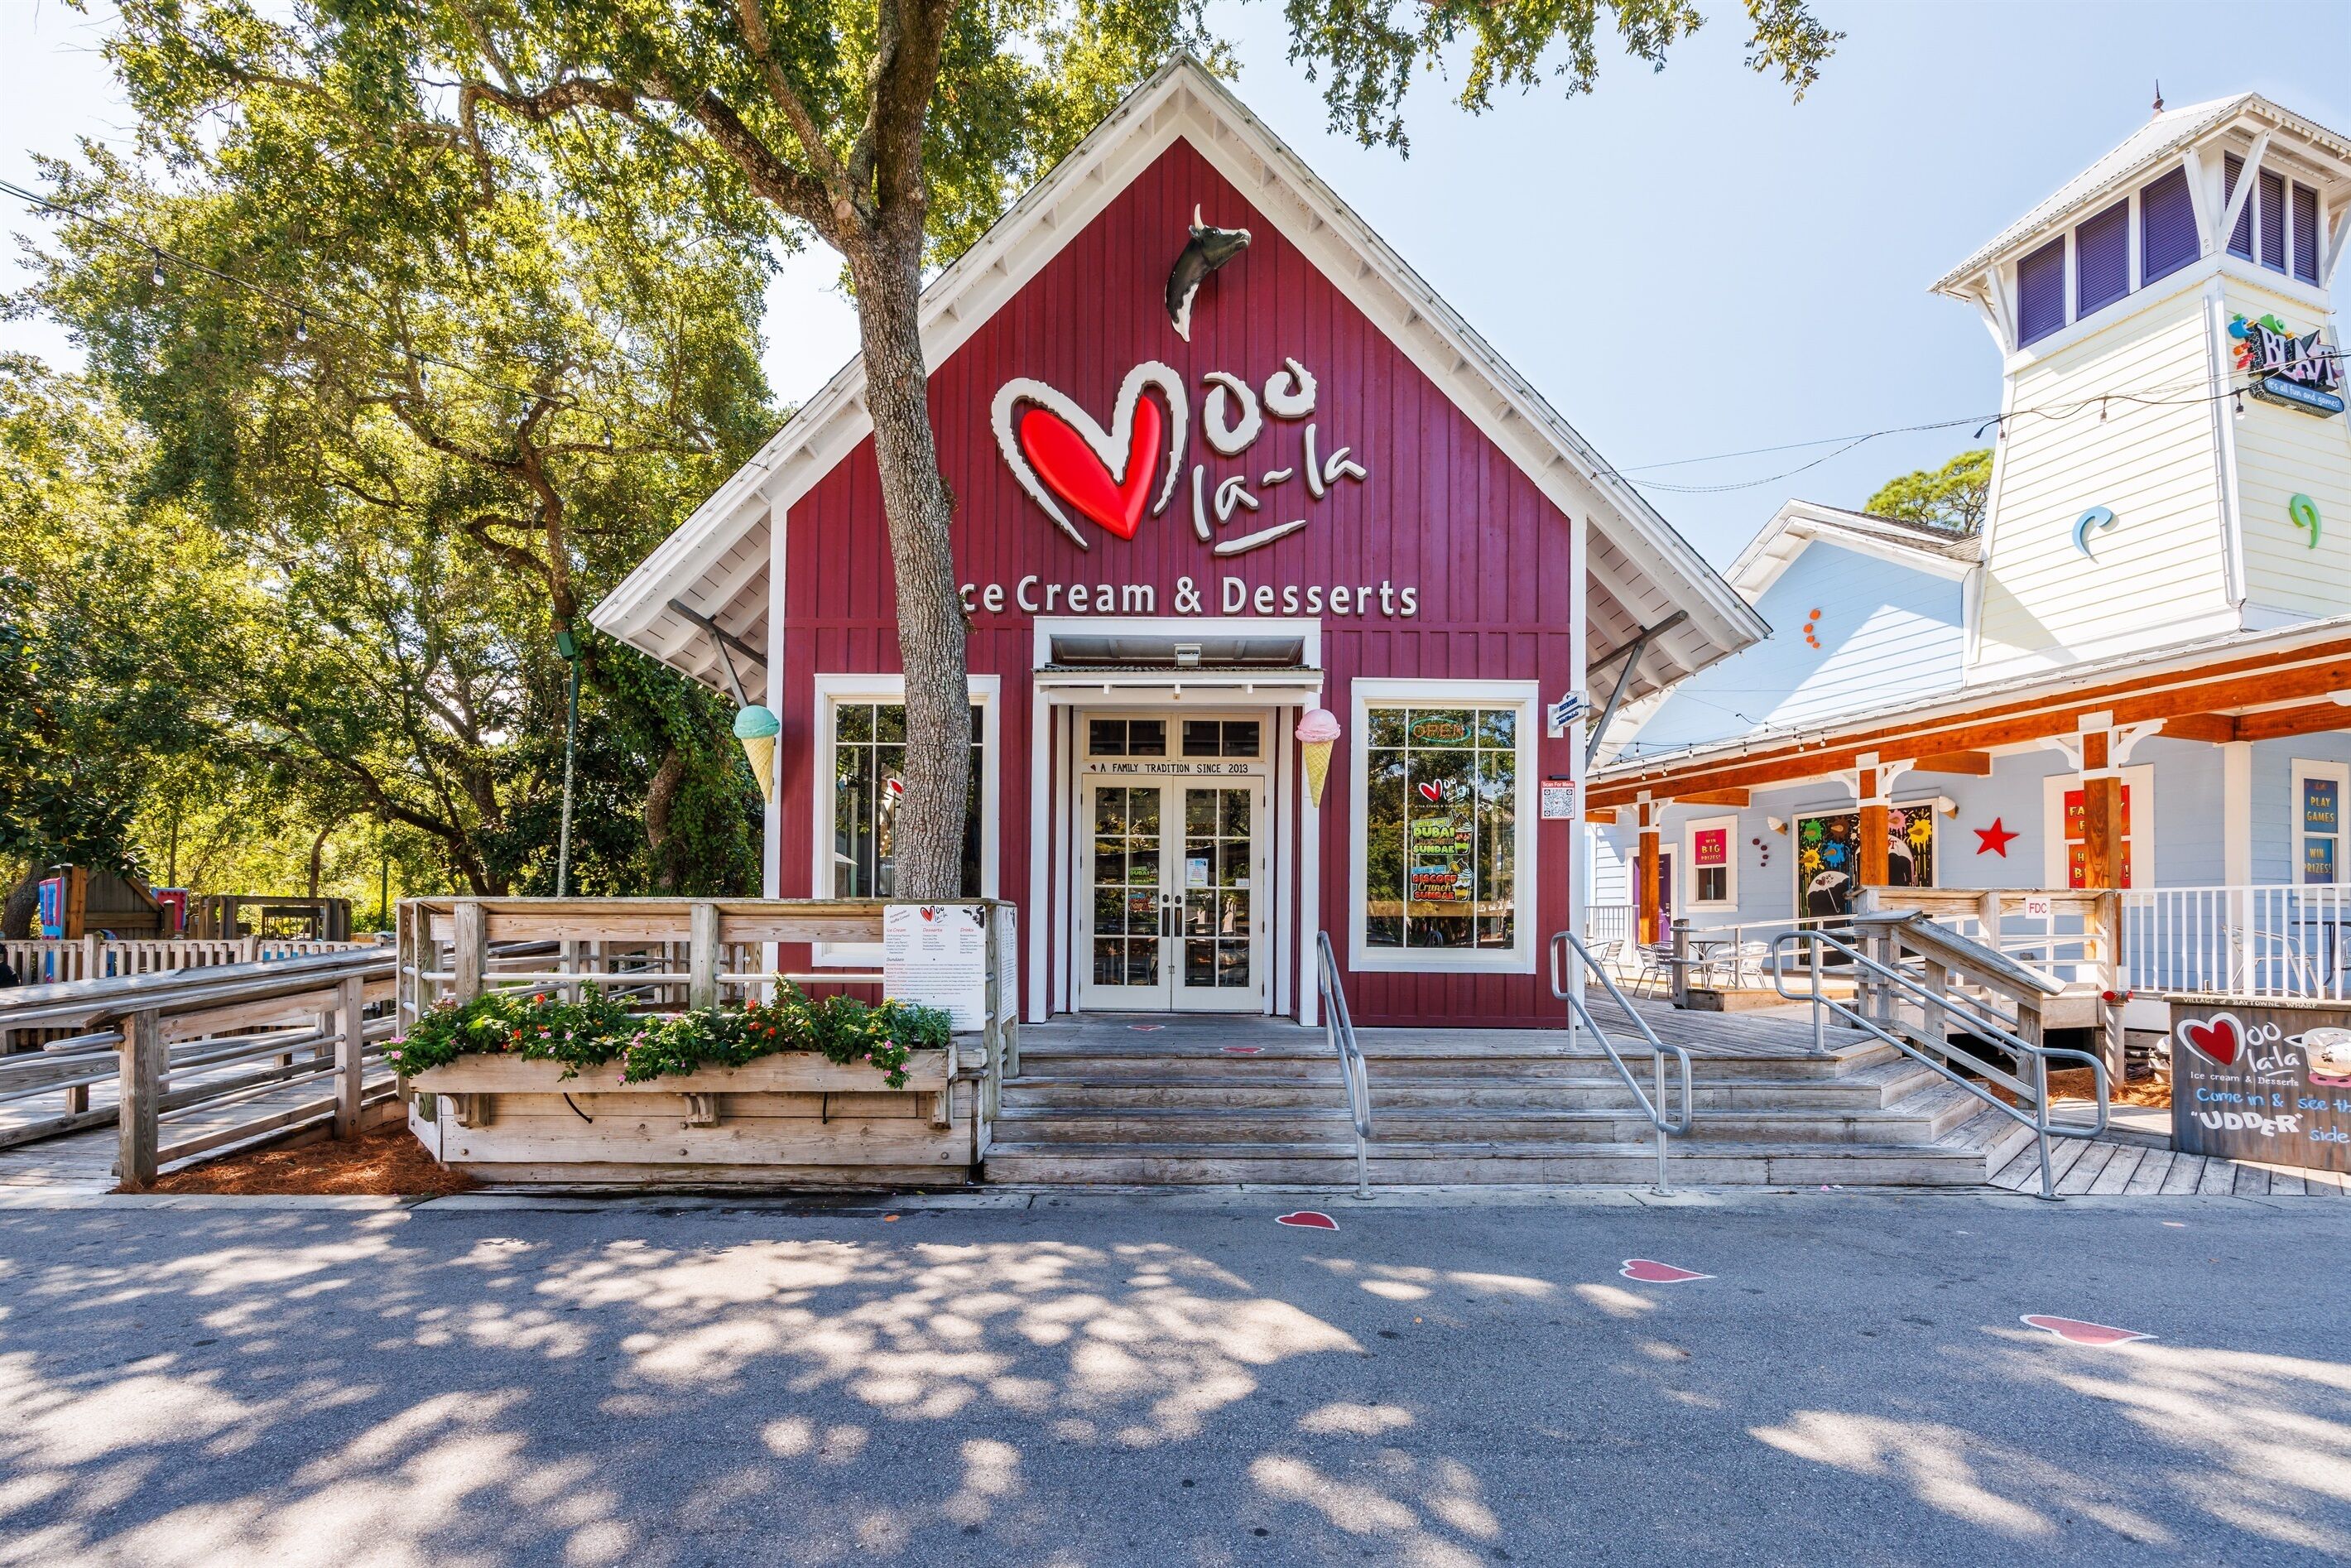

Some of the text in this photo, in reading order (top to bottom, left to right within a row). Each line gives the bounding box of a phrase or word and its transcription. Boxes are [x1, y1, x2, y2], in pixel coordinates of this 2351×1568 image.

[2267, 380, 2277, 390] It's
[2290, 385, 2301, 397] fun
[2303, 392, 2315, 402] and
[2318, 397, 2339, 407] games!
[959, 575, 1418, 617] ce Cream & Desserts
[1413, 724, 1464, 738] OPEN
[1100, 763, 1248, 773] A FAMILY TRADITION SINCE 2013
[2310, 796, 2330, 808] PLAY
[2307, 810, 2334, 823] GAMES
[1413, 827, 1455, 838] DUBAI
[1412, 845, 1455, 854] SUNDAE
[1701, 844, 1720, 854] BIG
[2310, 848, 2325, 859] WIN
[1412, 874, 1457, 884] BISCOFF
[1417, 882, 1452, 892] Crunch
[1414, 892, 1454, 900] SUNDAE
[2029, 902, 2047, 915] FDC
[2233, 999, 2280, 1008] BAYTOWNE
[2286, 1001, 2318, 1009] WHARF
[2190, 1071, 2300, 1087] Ice cream & Desserts
[2196, 1087, 2243, 1104] Come
[2248, 1092, 2265, 1106] in
[2272, 1093, 2284, 1108] &
[2298, 1098, 2329, 1111] see
[2310, 1124, 2350, 1144] side
